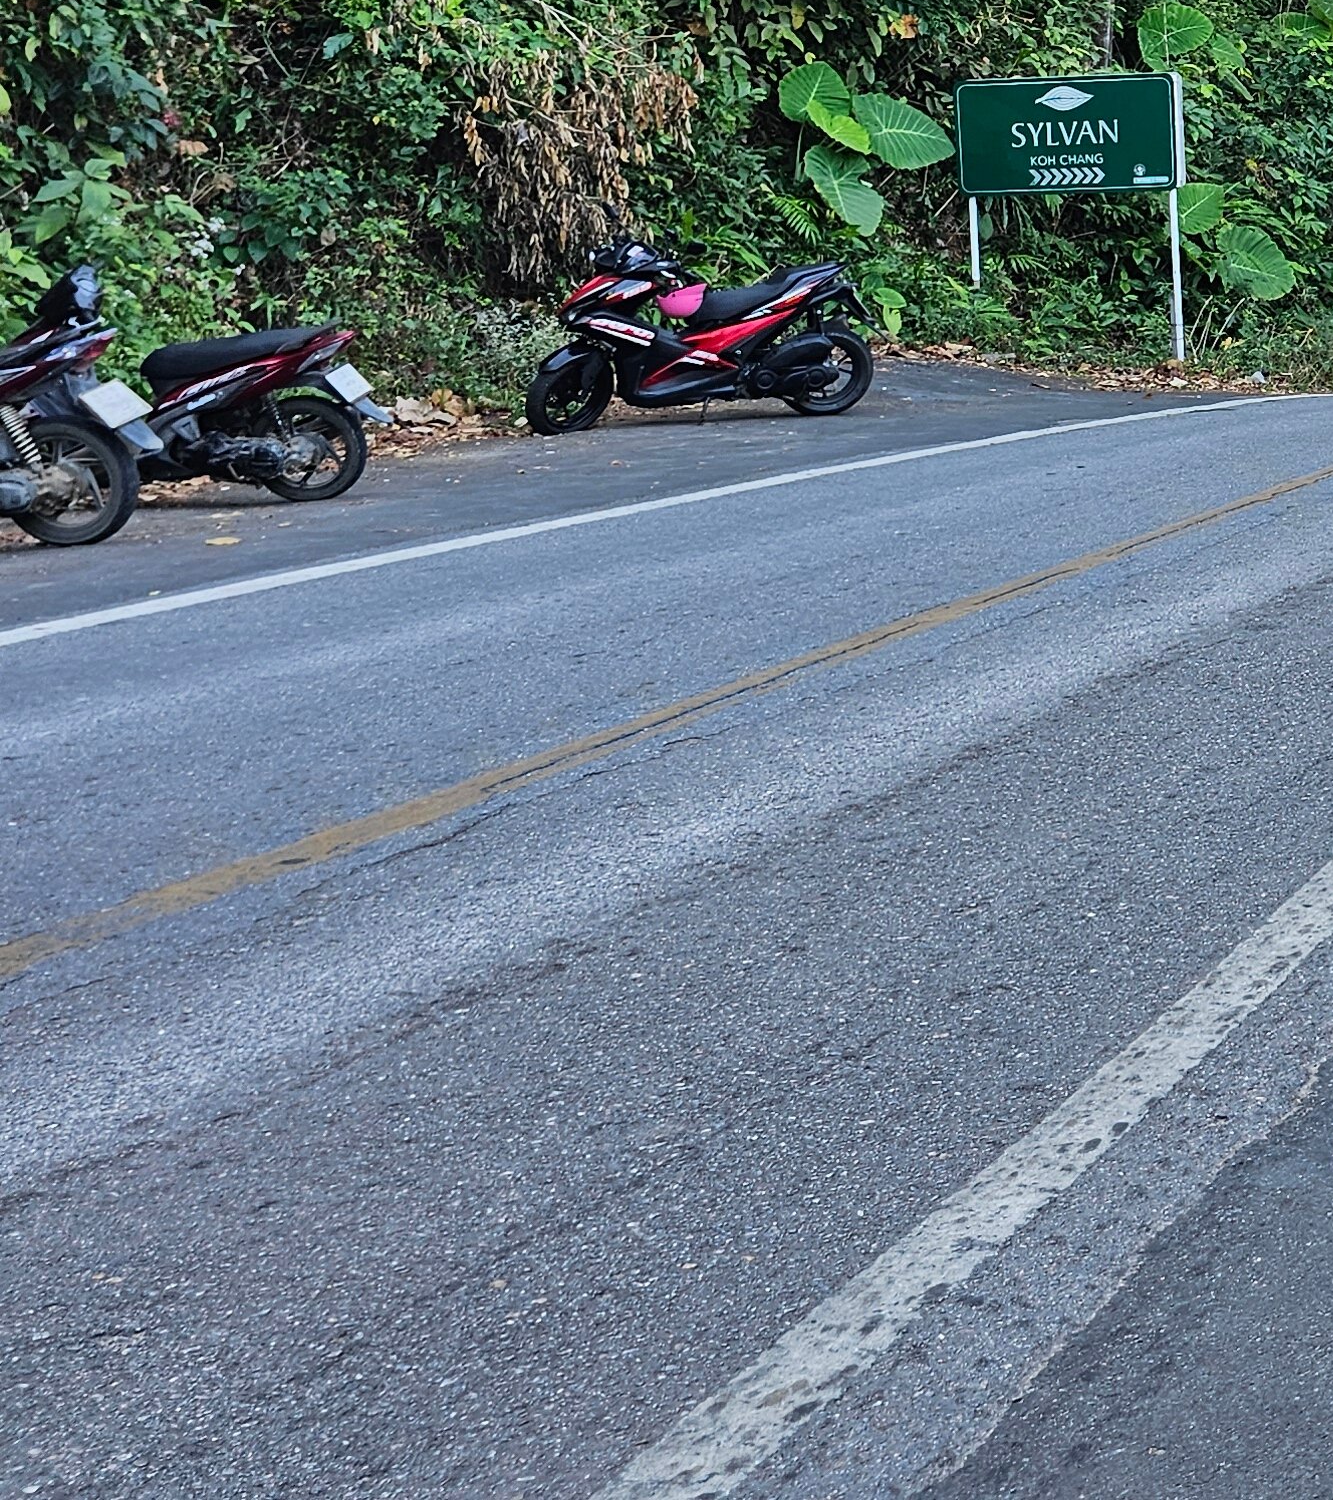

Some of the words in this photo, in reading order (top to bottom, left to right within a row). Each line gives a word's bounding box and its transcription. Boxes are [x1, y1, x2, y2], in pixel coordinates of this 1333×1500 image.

[1010, 118, 1119, 148] SYLVAN
[1030, 155, 1057, 167] KOH
[1059, 153, 1104, 166] CHANG
